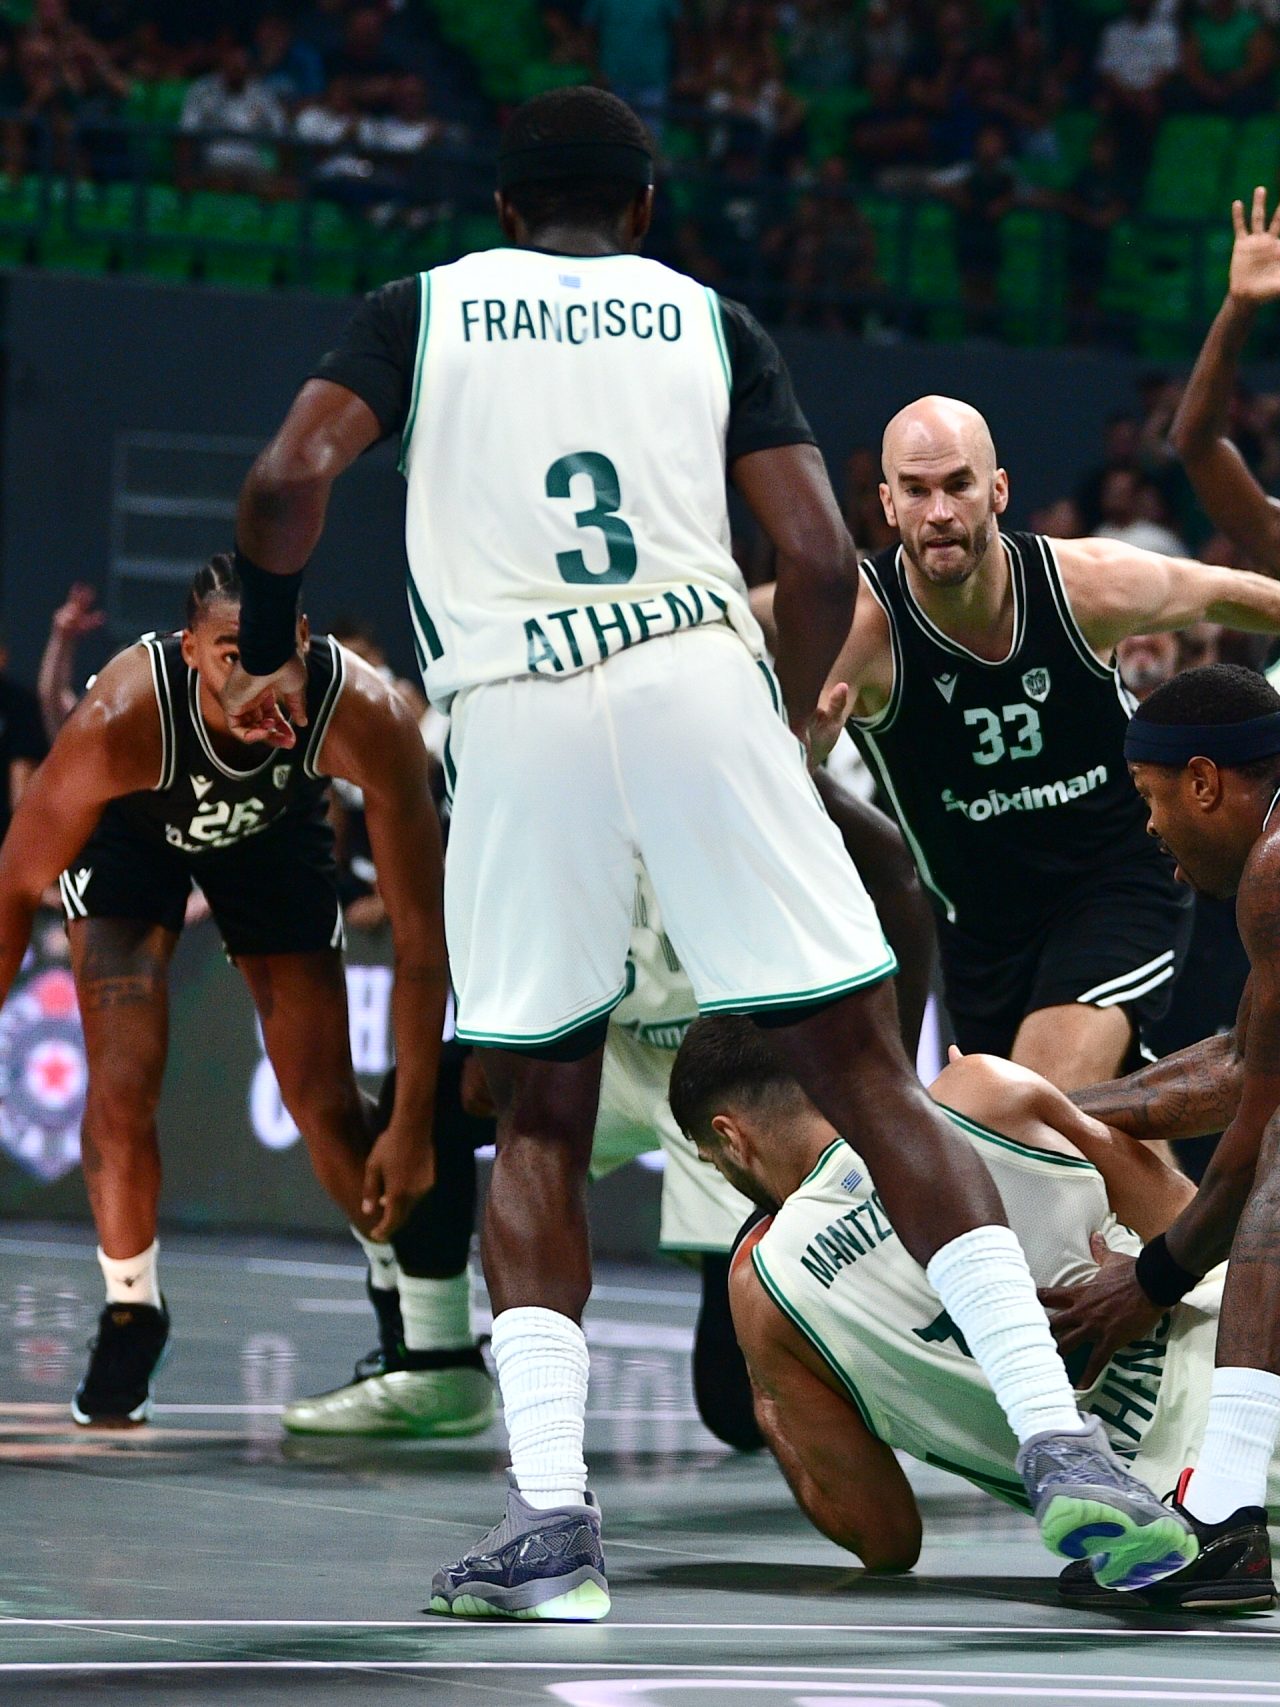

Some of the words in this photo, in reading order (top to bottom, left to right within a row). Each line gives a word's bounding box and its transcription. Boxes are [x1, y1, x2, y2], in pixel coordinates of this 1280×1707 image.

[461, 298, 682, 345] FRANCISCO
[545, 451, 638, 585] 3
[963, 703, 1044, 766] 33
